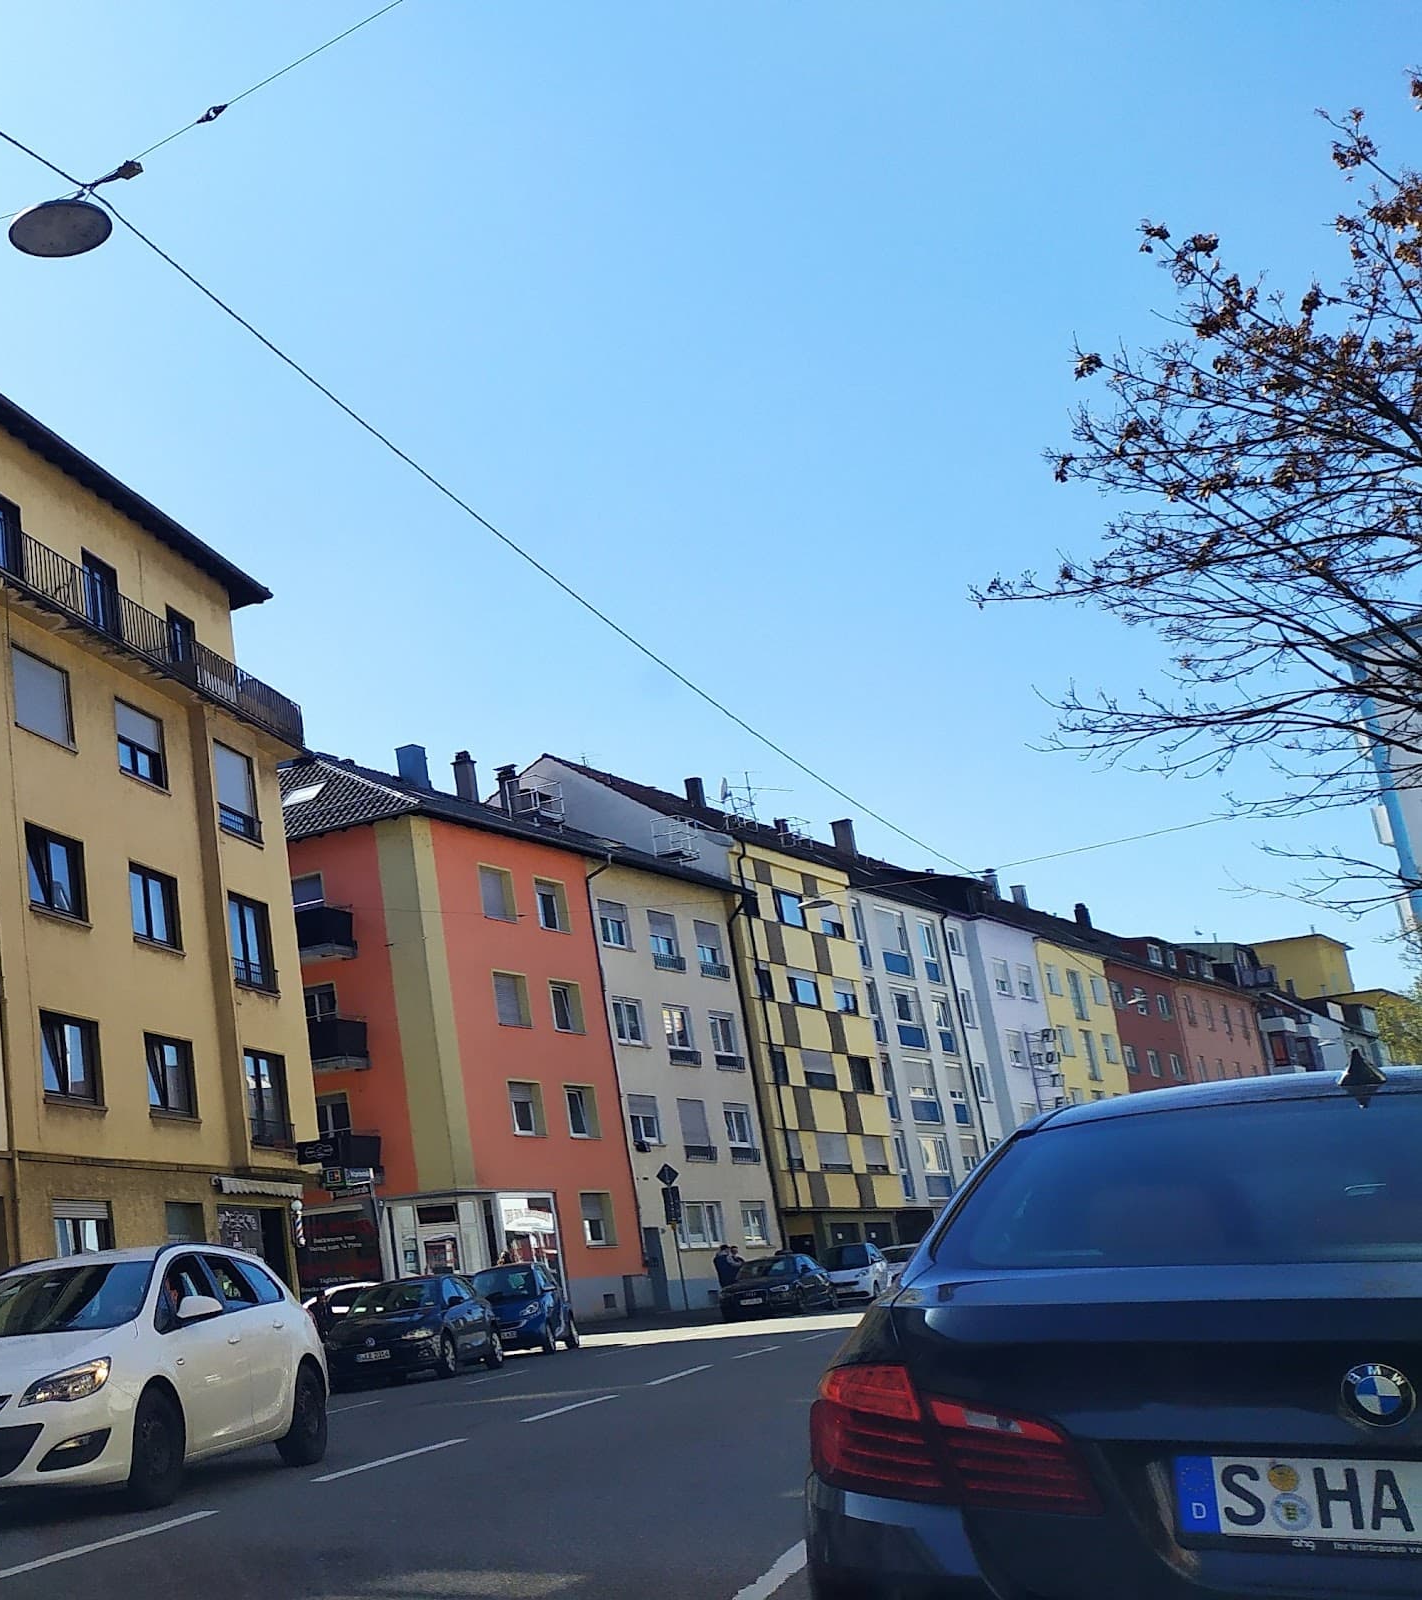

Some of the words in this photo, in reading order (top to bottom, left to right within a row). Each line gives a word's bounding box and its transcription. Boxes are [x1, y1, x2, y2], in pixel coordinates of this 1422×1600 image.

[1347, 1365, 1406, 1386] BMW
[1221, 1463, 1266, 1527] S
[1313, 1466, 1416, 1533] HA
[1191, 1502, 1207, 1520] D
